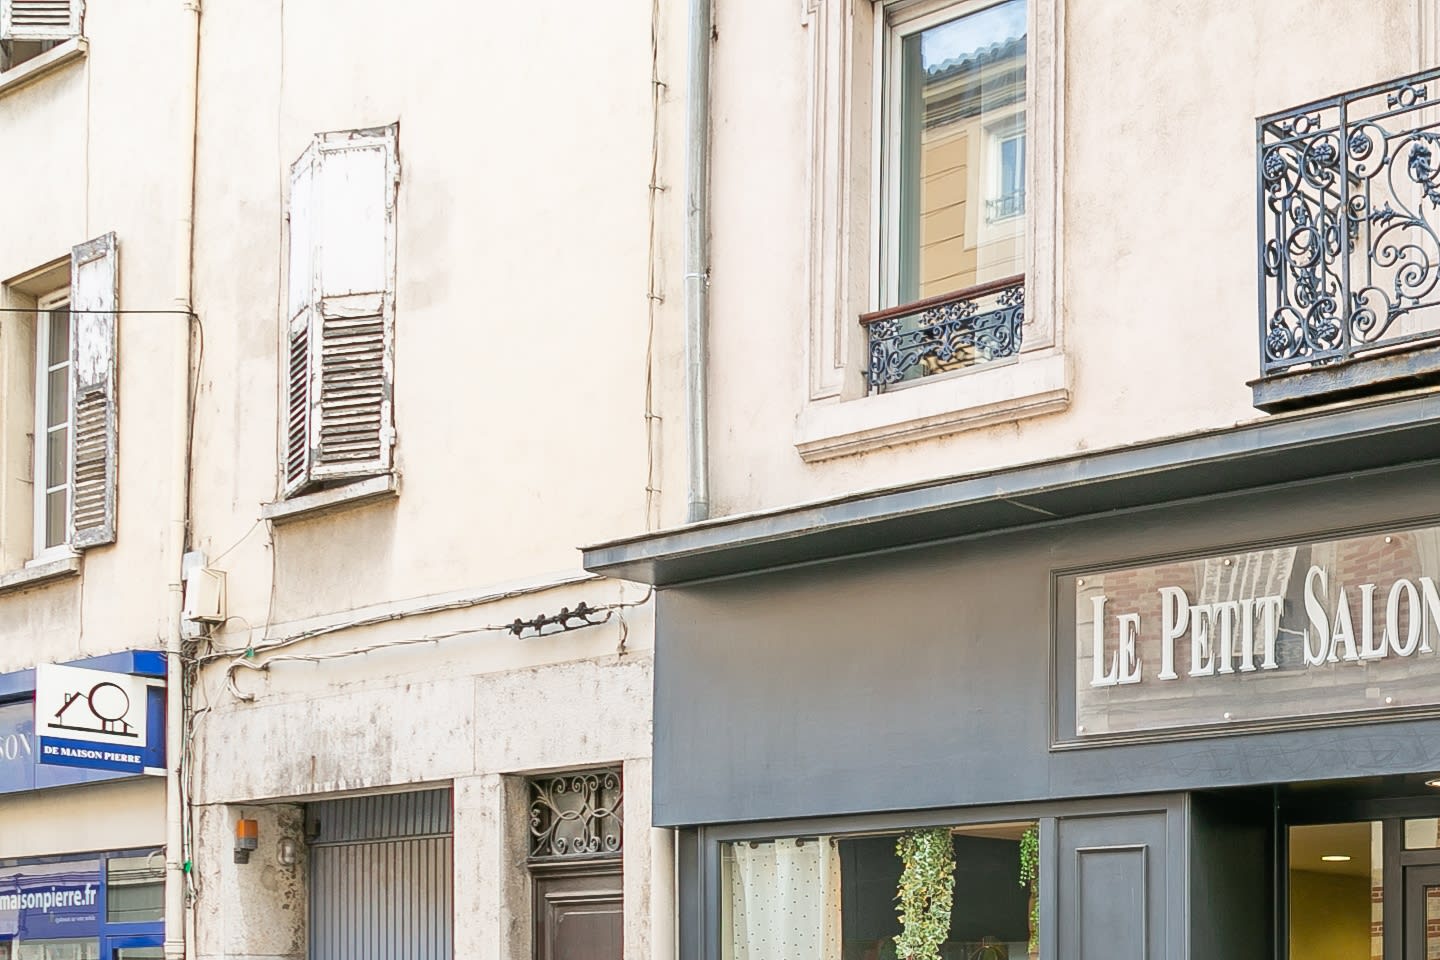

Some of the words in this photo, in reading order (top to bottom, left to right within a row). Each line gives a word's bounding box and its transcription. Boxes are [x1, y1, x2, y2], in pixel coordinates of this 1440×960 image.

[1090, 595, 1141, 687] LE
[1157, 586, 1285, 681] PETIT
[44, 745, 59, 755] DE
[60, 747, 103, 760] MAISON
[104, 752, 142, 763] PIERRE
